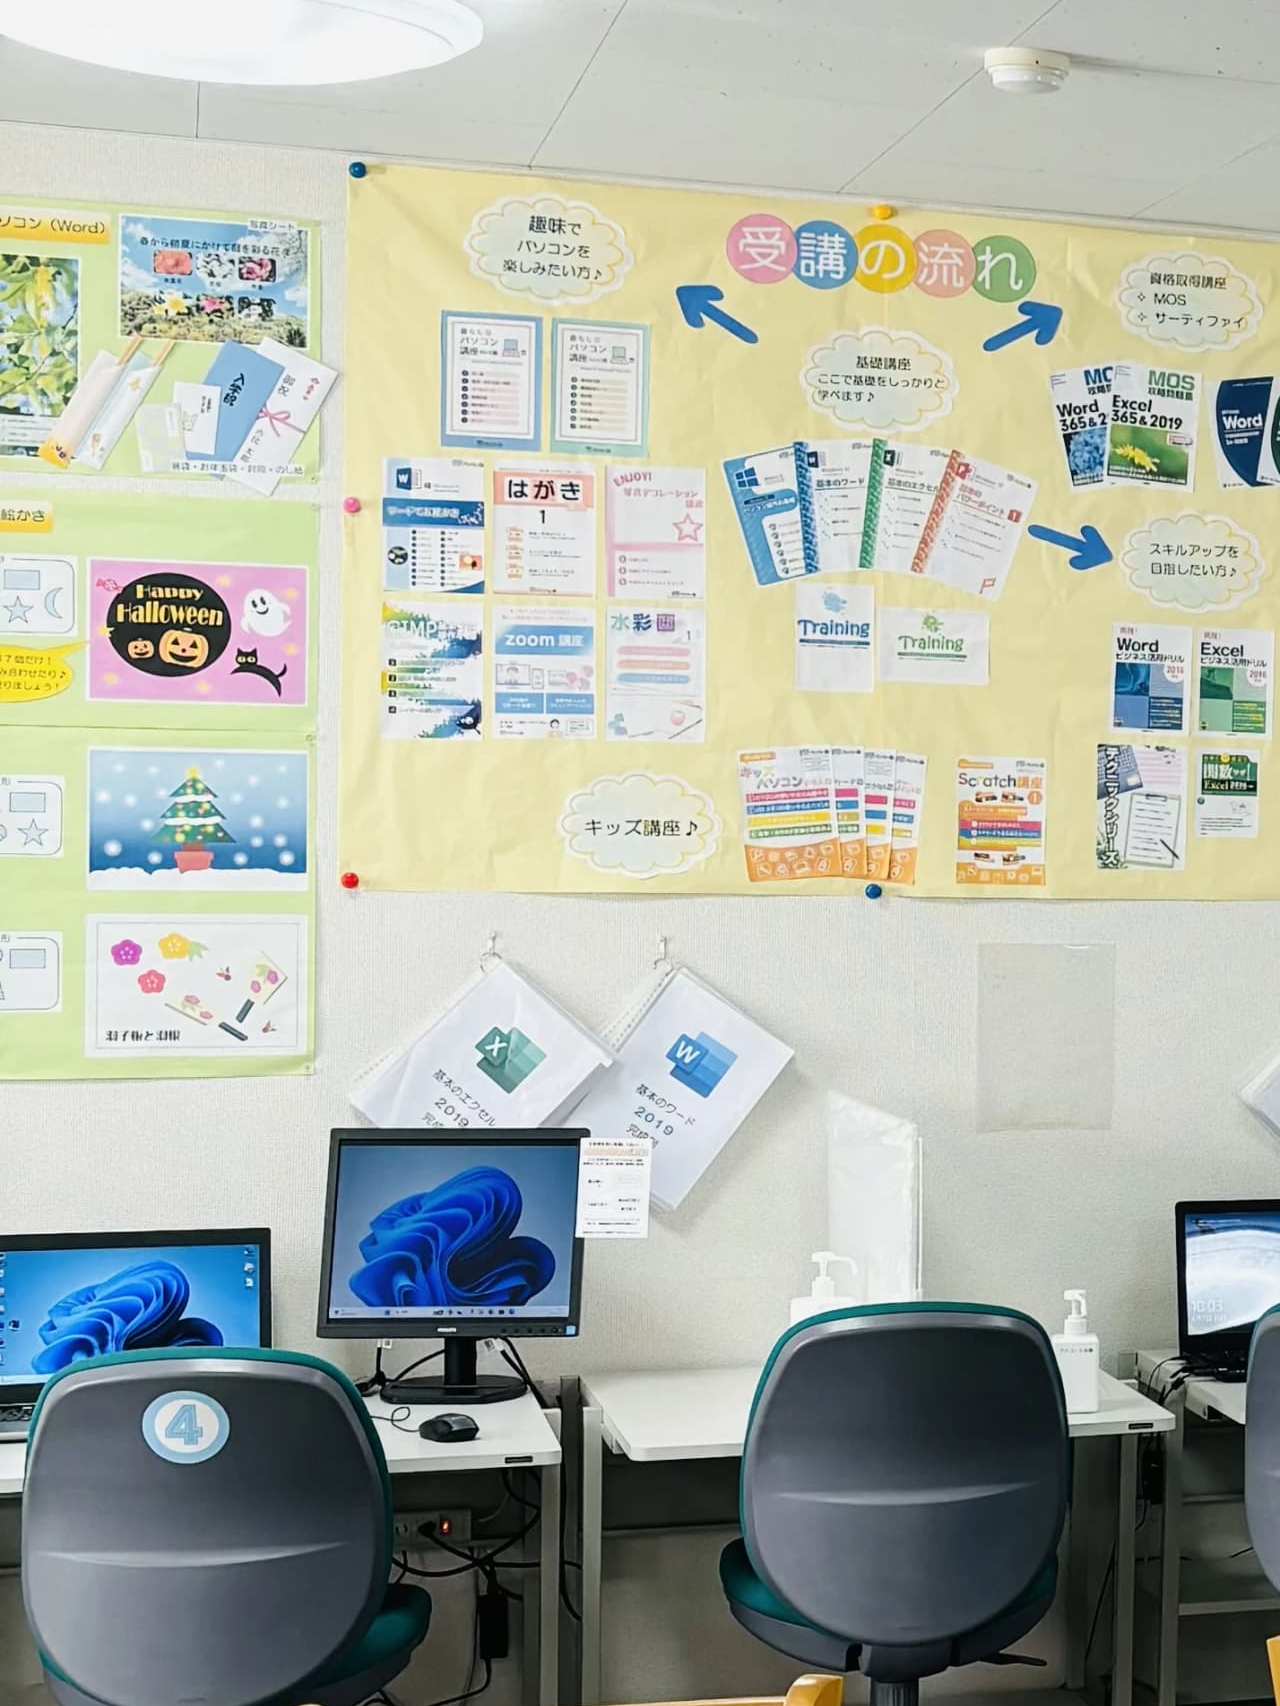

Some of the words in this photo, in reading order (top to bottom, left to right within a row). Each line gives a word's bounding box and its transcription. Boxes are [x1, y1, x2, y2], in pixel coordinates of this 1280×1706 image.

[528, 215, 582, 235] 趣味で
[517, 240, 591, 259] パソコンを
[738, 225, 1024, 291] 受講の流れ
[1154, 292, 1187, 306] MOS
[1156, 313, 1246, 329] サーティファイ
[855, 355, 912, 371] 基礎講座
[817, 374, 946, 390] ここで基礎をしっかりと
[1149, 369, 1195, 391] MOS
[1057, 399, 1100, 418] Word
[1112, 394, 1152, 413] Excel
[1223, 413, 1263, 429] Word
[507, 479, 581, 501] はがき
[539, 509, 546, 524] 1
[1149, 542, 1240, 559] スキルアップを
[135, 583, 204, 601] Happy
[116, 600, 223, 627] Halloween
[610, 613, 675, 632] 水彩画
[797, 619, 871, 638] Training
[504, 634, 556, 647] zoom
[897, 634, 965, 653] Training
[1117, 638, 1160, 653] Word
[1200, 642, 1244, 657] Excel
[485, 1036, 508, 1059] X
[674, 1039, 701, 1065] W
[432, 1068, 497, 1127] 基本のエクセル
[635, 1083, 697, 1126] 基本のワード
[164, 1403, 204, 1446] 4
